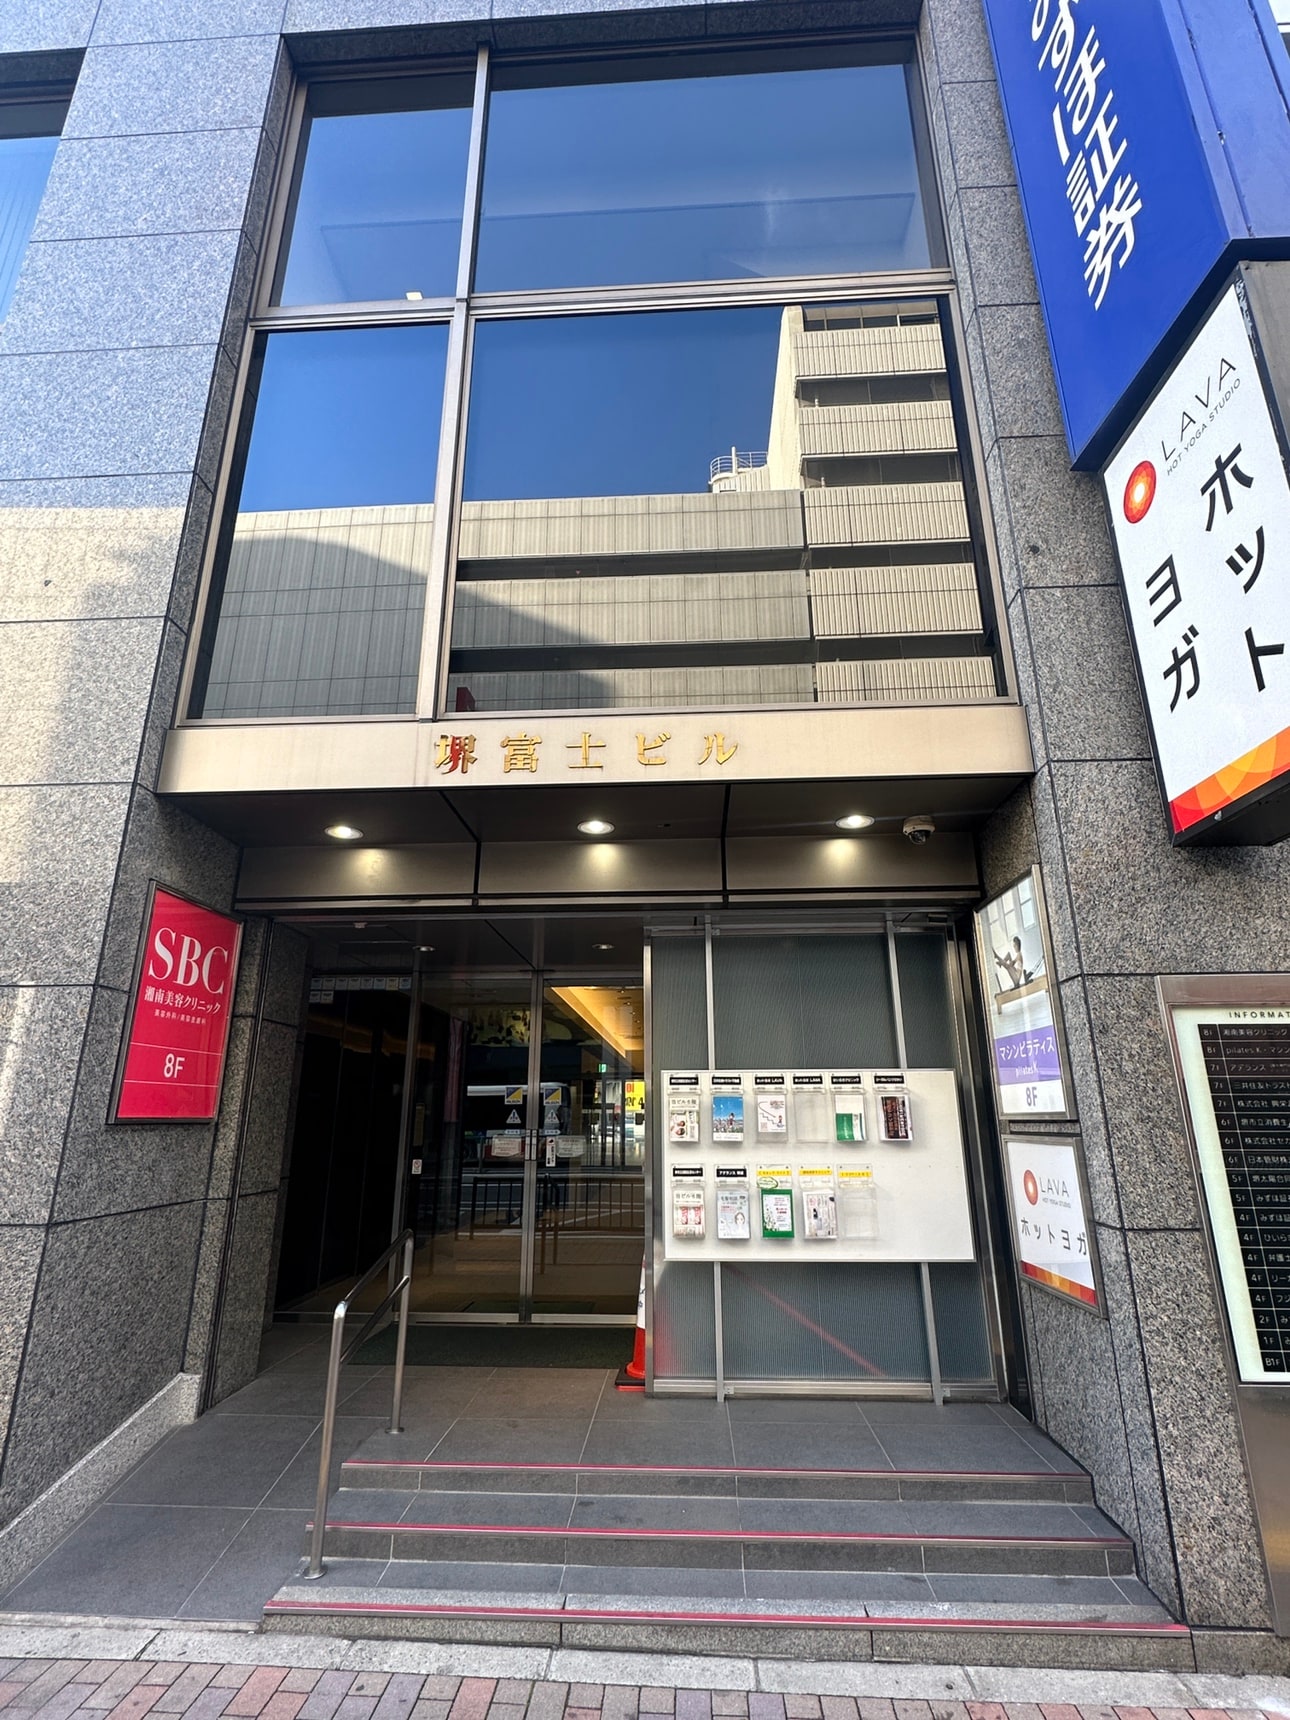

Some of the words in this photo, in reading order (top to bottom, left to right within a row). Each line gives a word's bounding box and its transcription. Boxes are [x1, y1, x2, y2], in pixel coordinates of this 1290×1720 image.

[1161, 357, 1237, 462] LAVA
[1166, 452, 1183, 476] HOT
[1183, 423, 1208, 452] YOGA
[1208, 378, 1241, 422] STUDIO
[1200, 442, 1285, 693] ホット
[1145, 553, 1200, 714] ヨガ
[433, 730, 739, 775] 堺富士ビル
[148, 927, 229, 995] SBC
[144, 985, 222, 1015] 湘南美容クリニック
[998, 1036, 1056, 1062] マシンピラティス
[163, 1053, 186, 1079] 8F
[1025, 1086, 1038, 1108] 8F
[1039, 1176, 1070, 1198] LAVA
[1232, 1174, 1242, 1182] 5F
[1236, 1194, 1246, 1202] 5F
[1239, 1213, 1250, 1222] 4F
[1020, 1216, 1088, 1256] ホットヨガ
[1243, 1233, 1254, 1241] 4F
[1247, 1253, 1258, 1261] 4F
[1251, 1273, 1263, 1282] 4F
[1255, 1294, 1267, 1302] 4F
[1259, 1315, 1271, 1324] 2F
[1263, 1336, 1275, 1345] 1F
[1265, 1357, 1280, 1367] B1F
